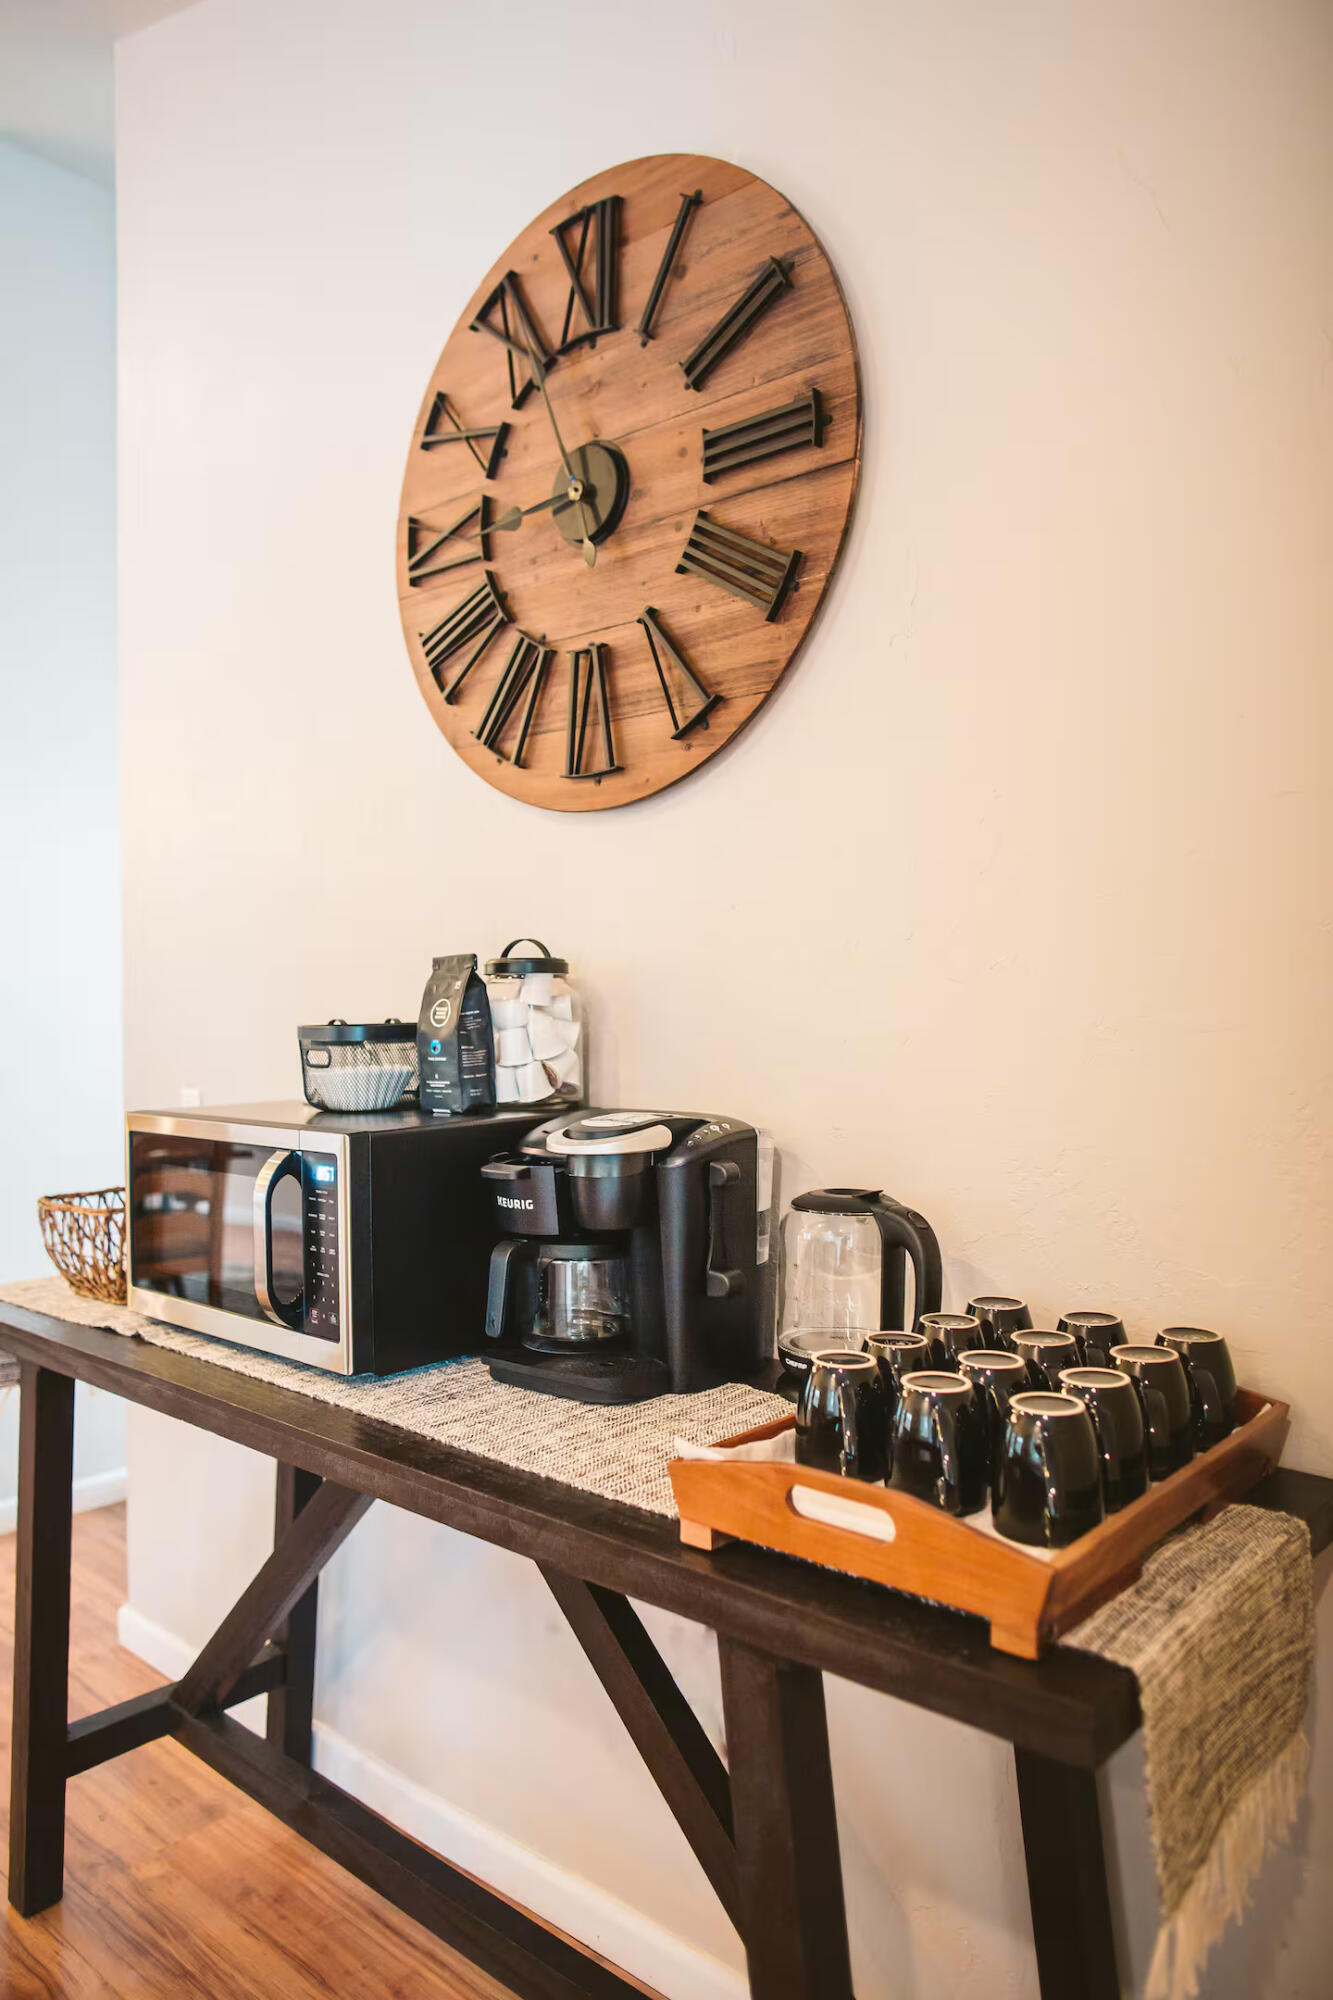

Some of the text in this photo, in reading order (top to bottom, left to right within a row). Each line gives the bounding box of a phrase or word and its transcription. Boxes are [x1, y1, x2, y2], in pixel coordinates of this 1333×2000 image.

[549, 194, 624, 354] XII
[637, 190, 702, 345] I
[678, 257, 794, 391] II
[469, 270, 558, 409] XI
[421, 391, 510, 480] X
[702, 388, 824, 483] III
[408, 495, 490, 587] IX
[675, 510, 804, 621] IIII
[419, 569, 514, 704] VIII
[469, 629, 556, 768] VII
[638, 607, 723, 740] V
[560, 643, 624, 780] VI
[496, 1195, 534, 1210] KEURIG
